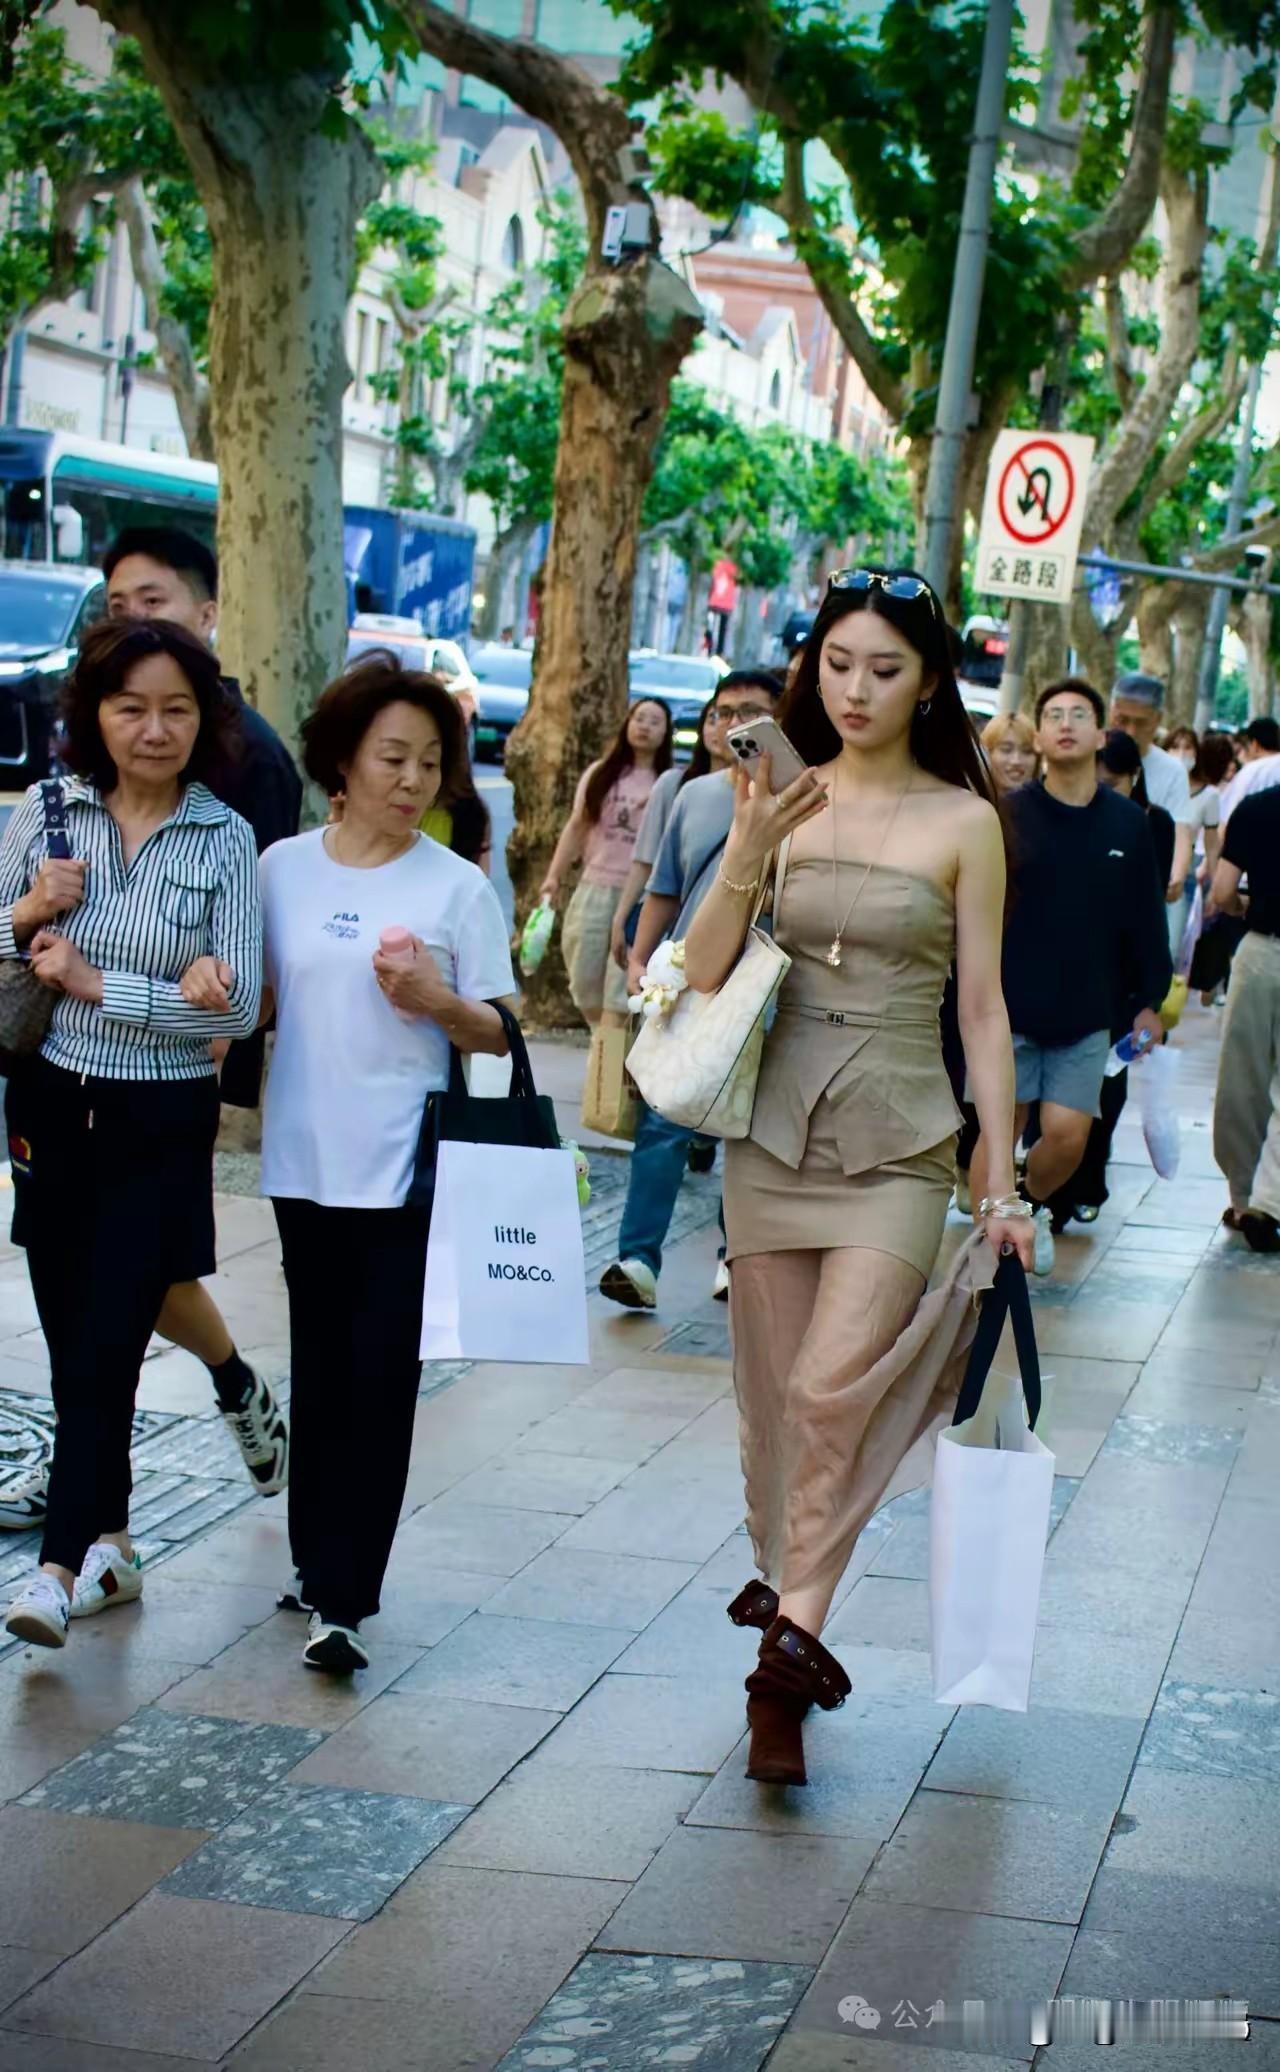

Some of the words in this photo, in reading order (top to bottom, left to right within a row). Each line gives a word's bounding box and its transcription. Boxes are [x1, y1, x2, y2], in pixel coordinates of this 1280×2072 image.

[989, 556, 1057, 589] 全路段
[333, 912, 359, 922] FILA
[495, 1225, 537, 1245] little
[487, 1263, 555, 1283] MO&Co.
